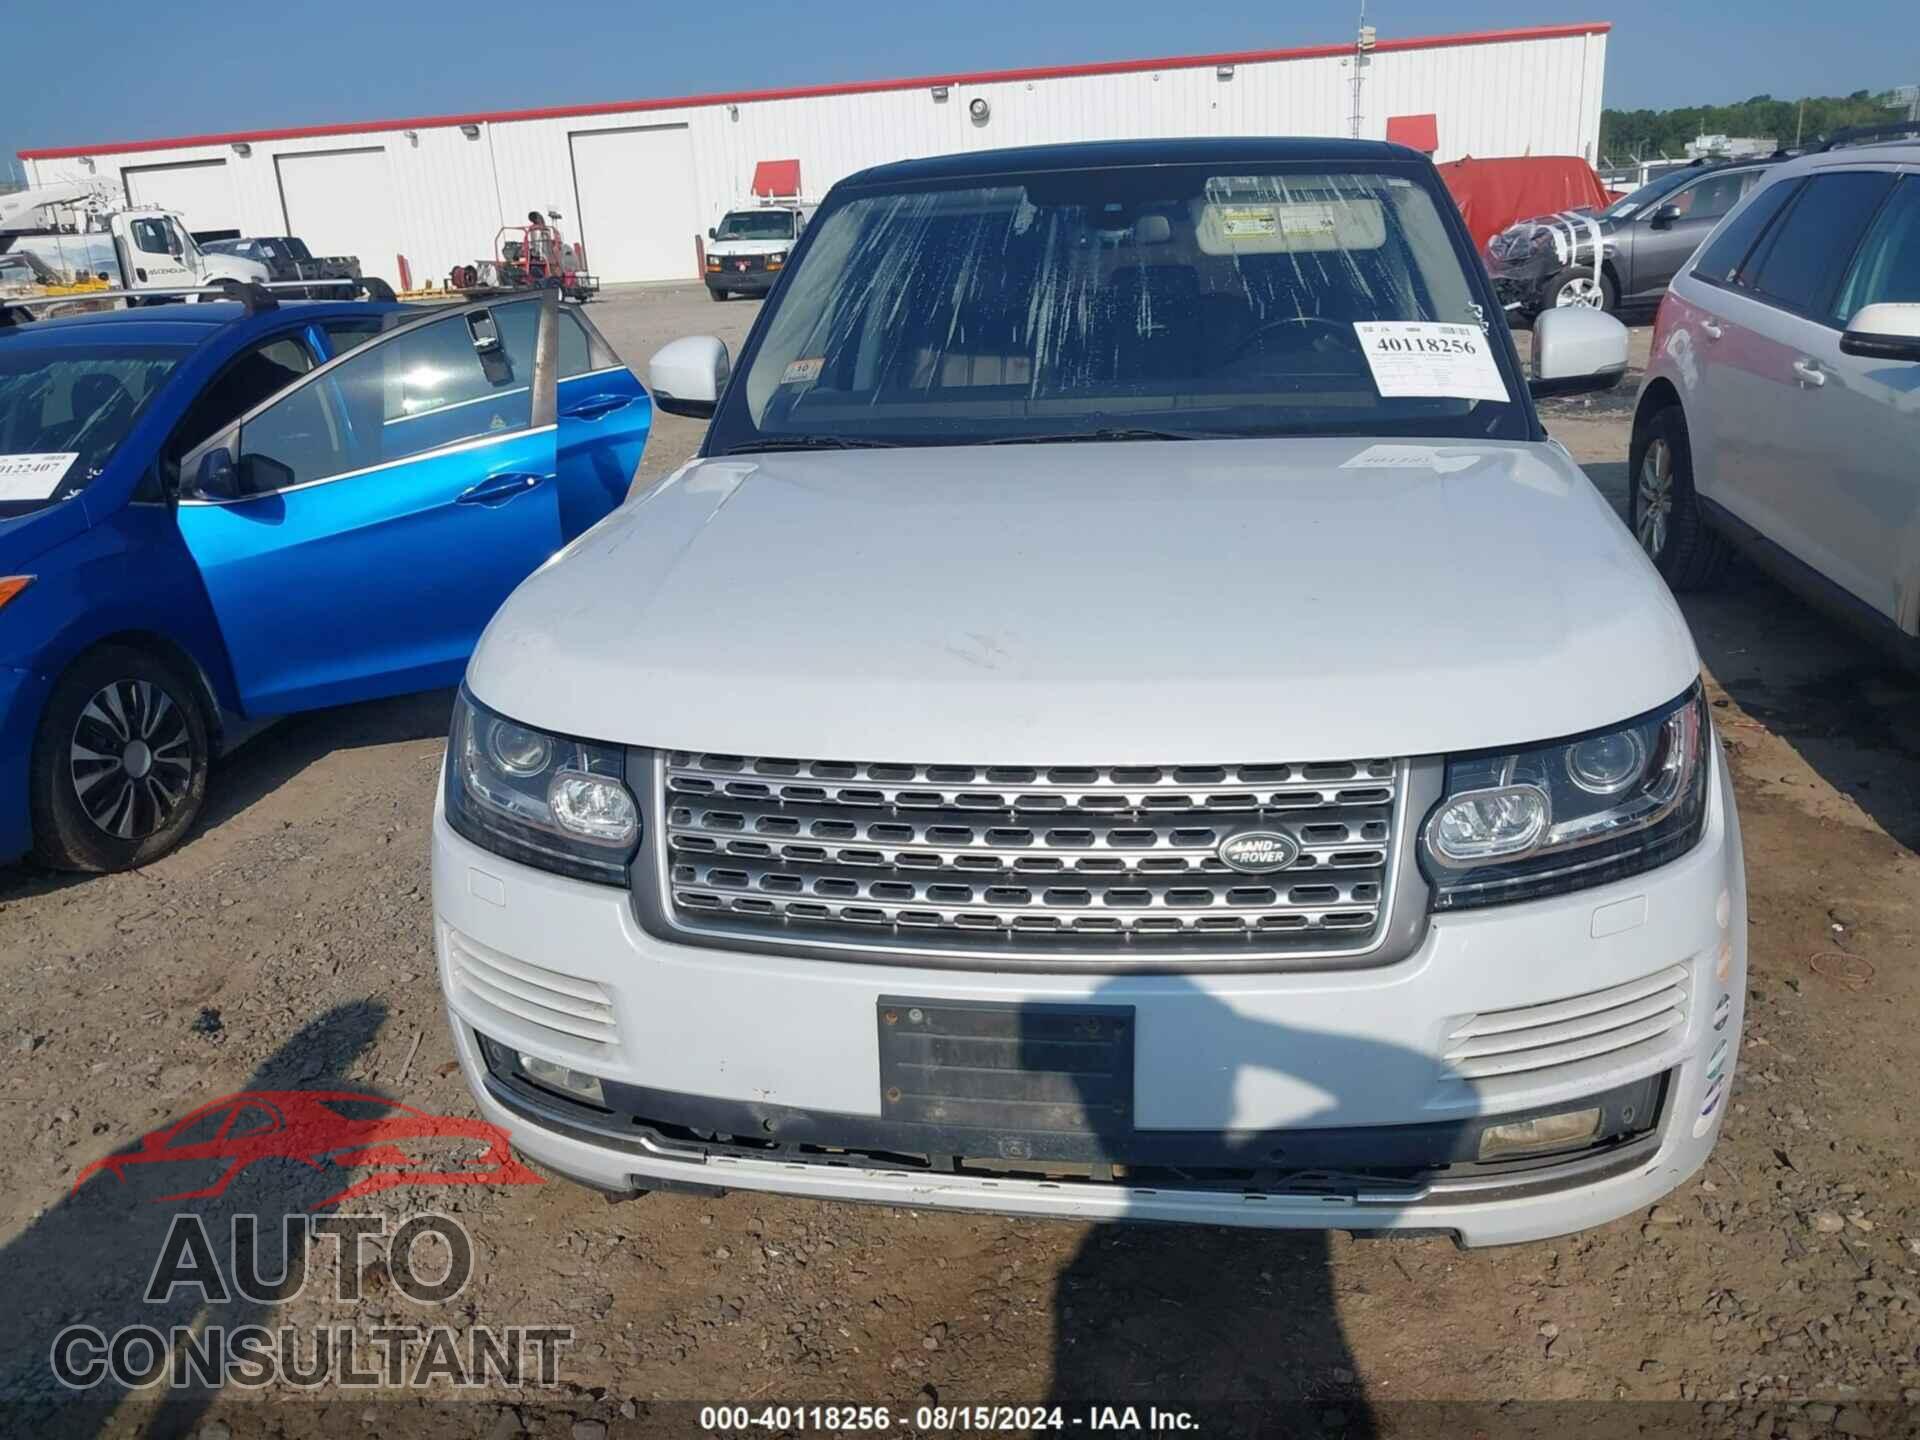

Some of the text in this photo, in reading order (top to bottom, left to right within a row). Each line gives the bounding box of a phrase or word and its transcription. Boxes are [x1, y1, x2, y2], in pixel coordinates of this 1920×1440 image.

[1377, 337, 1476, 355] 40118256
[1237, 839, 1273, 851] LAND
[1239, 851, 1284, 863] ROVER
